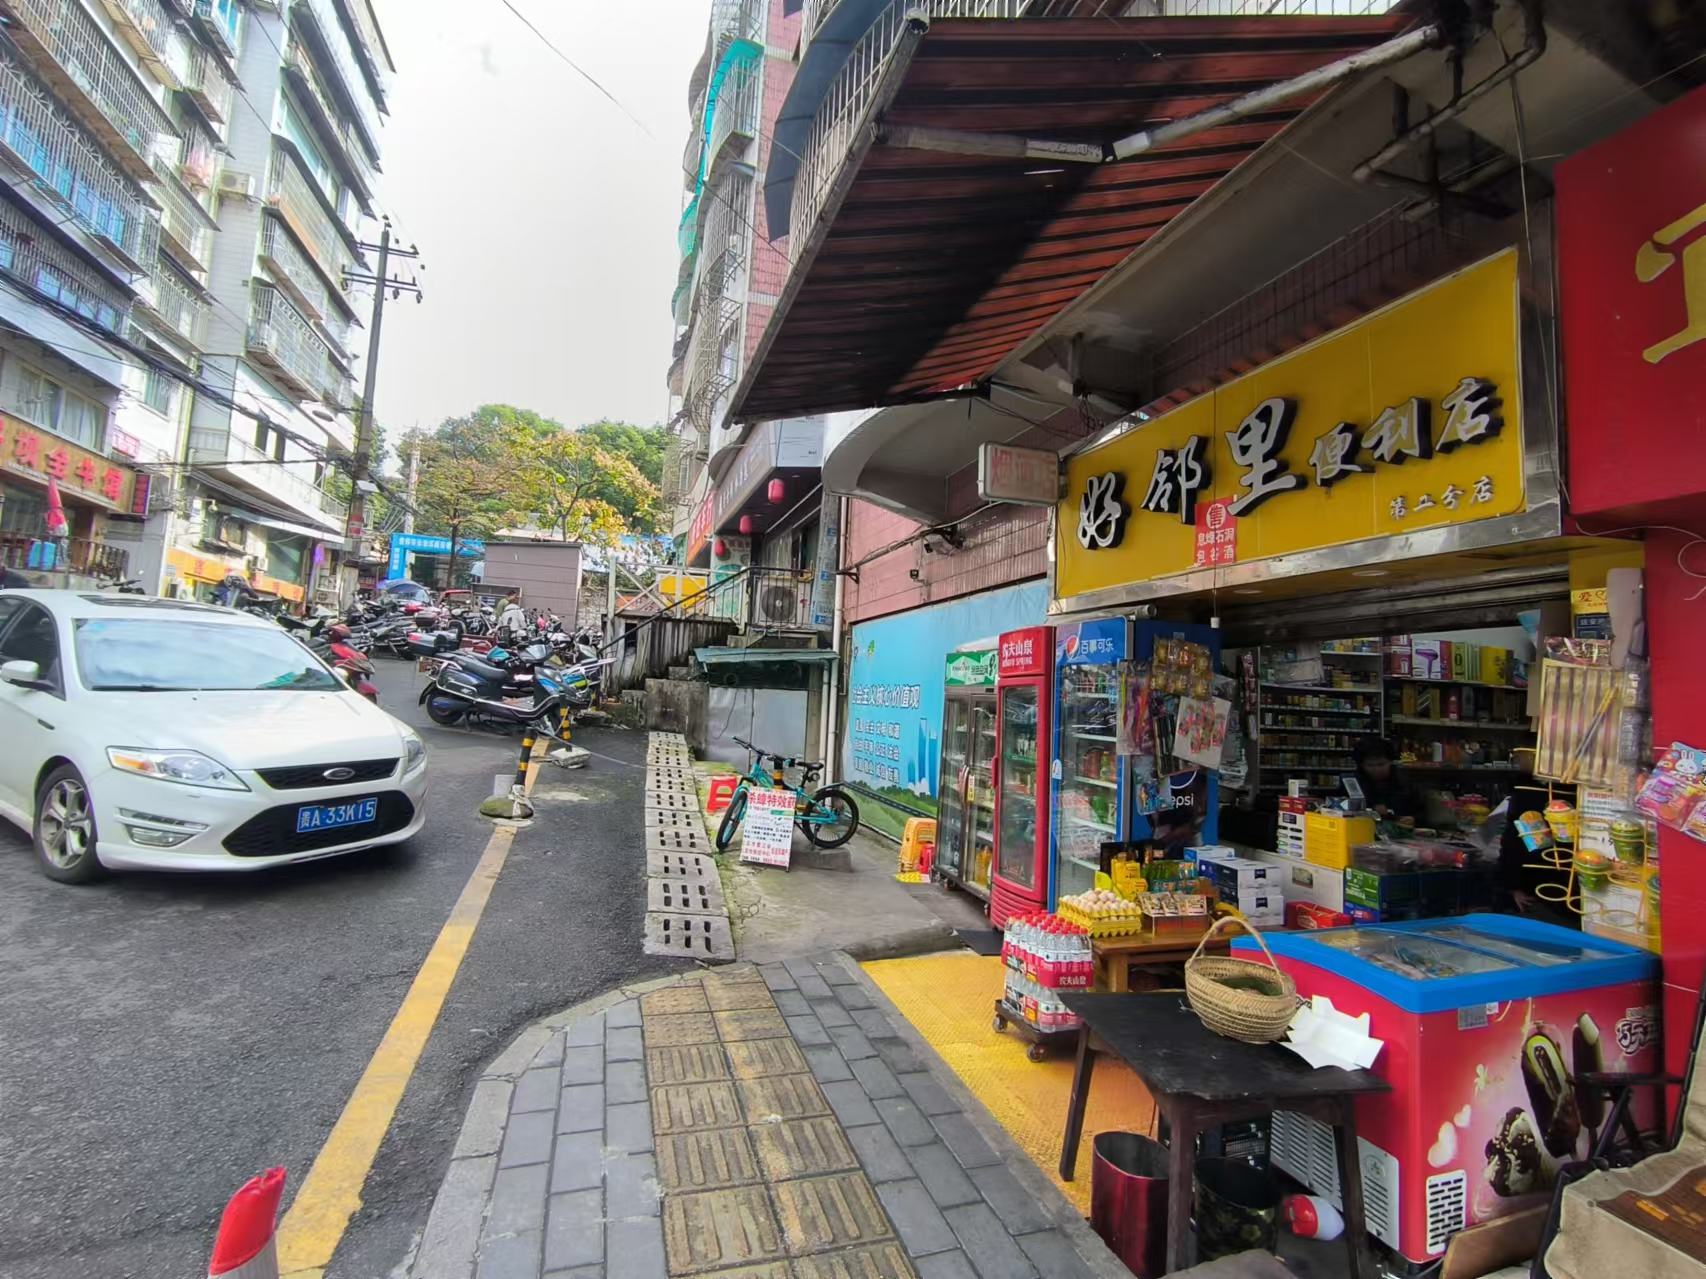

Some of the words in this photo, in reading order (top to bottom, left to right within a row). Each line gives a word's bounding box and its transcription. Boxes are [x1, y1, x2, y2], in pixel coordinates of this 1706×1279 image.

[1077, 377, 1500, 548] 好邻里便利店
[1080, 637, 1115, 655] 百事可乐
[1169, 793, 1194, 809] epsi
